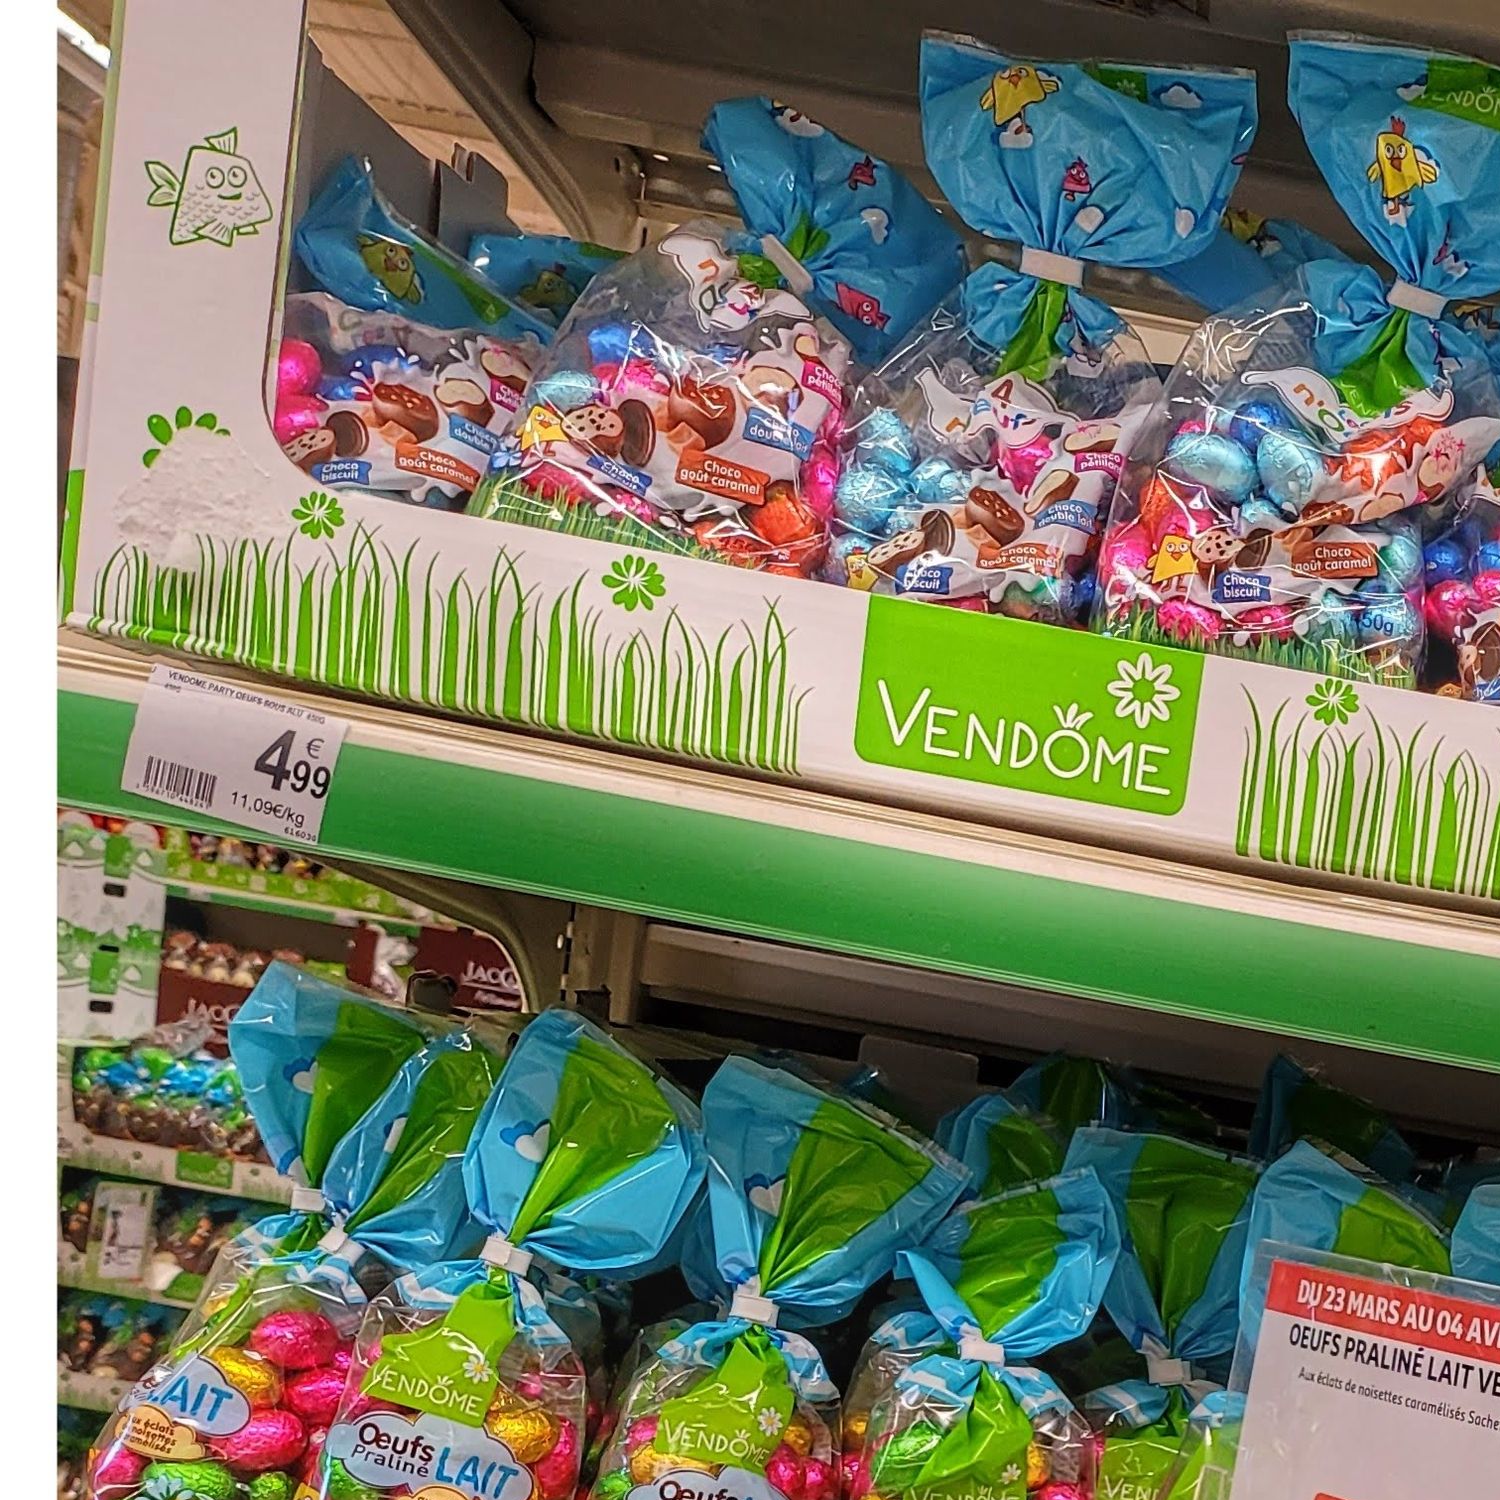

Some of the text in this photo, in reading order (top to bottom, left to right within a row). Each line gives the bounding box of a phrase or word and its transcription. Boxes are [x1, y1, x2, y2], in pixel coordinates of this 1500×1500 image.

[321, 470, 358, 482] biscuit
[322, 461, 358, 473] Choco
[399, 457, 427, 471] goût
[418, 451, 457, 467] Choco
[704, 459, 742, 479] Choco
[711, 474, 760, 495] caramel
[1315, 547, 1352, 558] Choco
[1326, 555, 1372, 571] caramel
[1223, 575, 1260, 587] Choco
[1223, 585, 1261, 598] biscuit
[167, 670, 208, 692] VENDOME
[207, 683, 236, 699] PARTY
[235, 691, 264, 706] OEUFS
[877, 679, 1171, 796] VENDÔME
[254, 729, 331, 800] 4 € 99
[231, 791, 305, 829] 11,09€/kg
[1297, 1279, 1323, 1308] DU
[1321, 1284, 1346, 1313] 23
[1347, 1291, 1402, 1326] MARS
[1401, 1302, 1436, 1333] AU
[1436, 1311, 1467, 1339] 04
[1289, 1323, 1342, 1358] OEUFS
[1344, 1336, 1426, 1378] PRALINÉ
[1427, 1358, 1476, 1390] LAIT
[373, 1364, 483, 1419] VENDÔME
[1298, 1365, 1317, 1383] Aux
[1316, 1369, 1344, 1391] éclats
[1344, 1377, 1358, 1395] de
[1357, 1380, 1404, 1407] noisettes
[1404, 1394, 1467, 1424] caramélisés
[664, 1418, 771, 1467] VENDÔME
[350, 1443, 430, 1479] Praliné
[434, 1447, 520, 1500] LAIT
